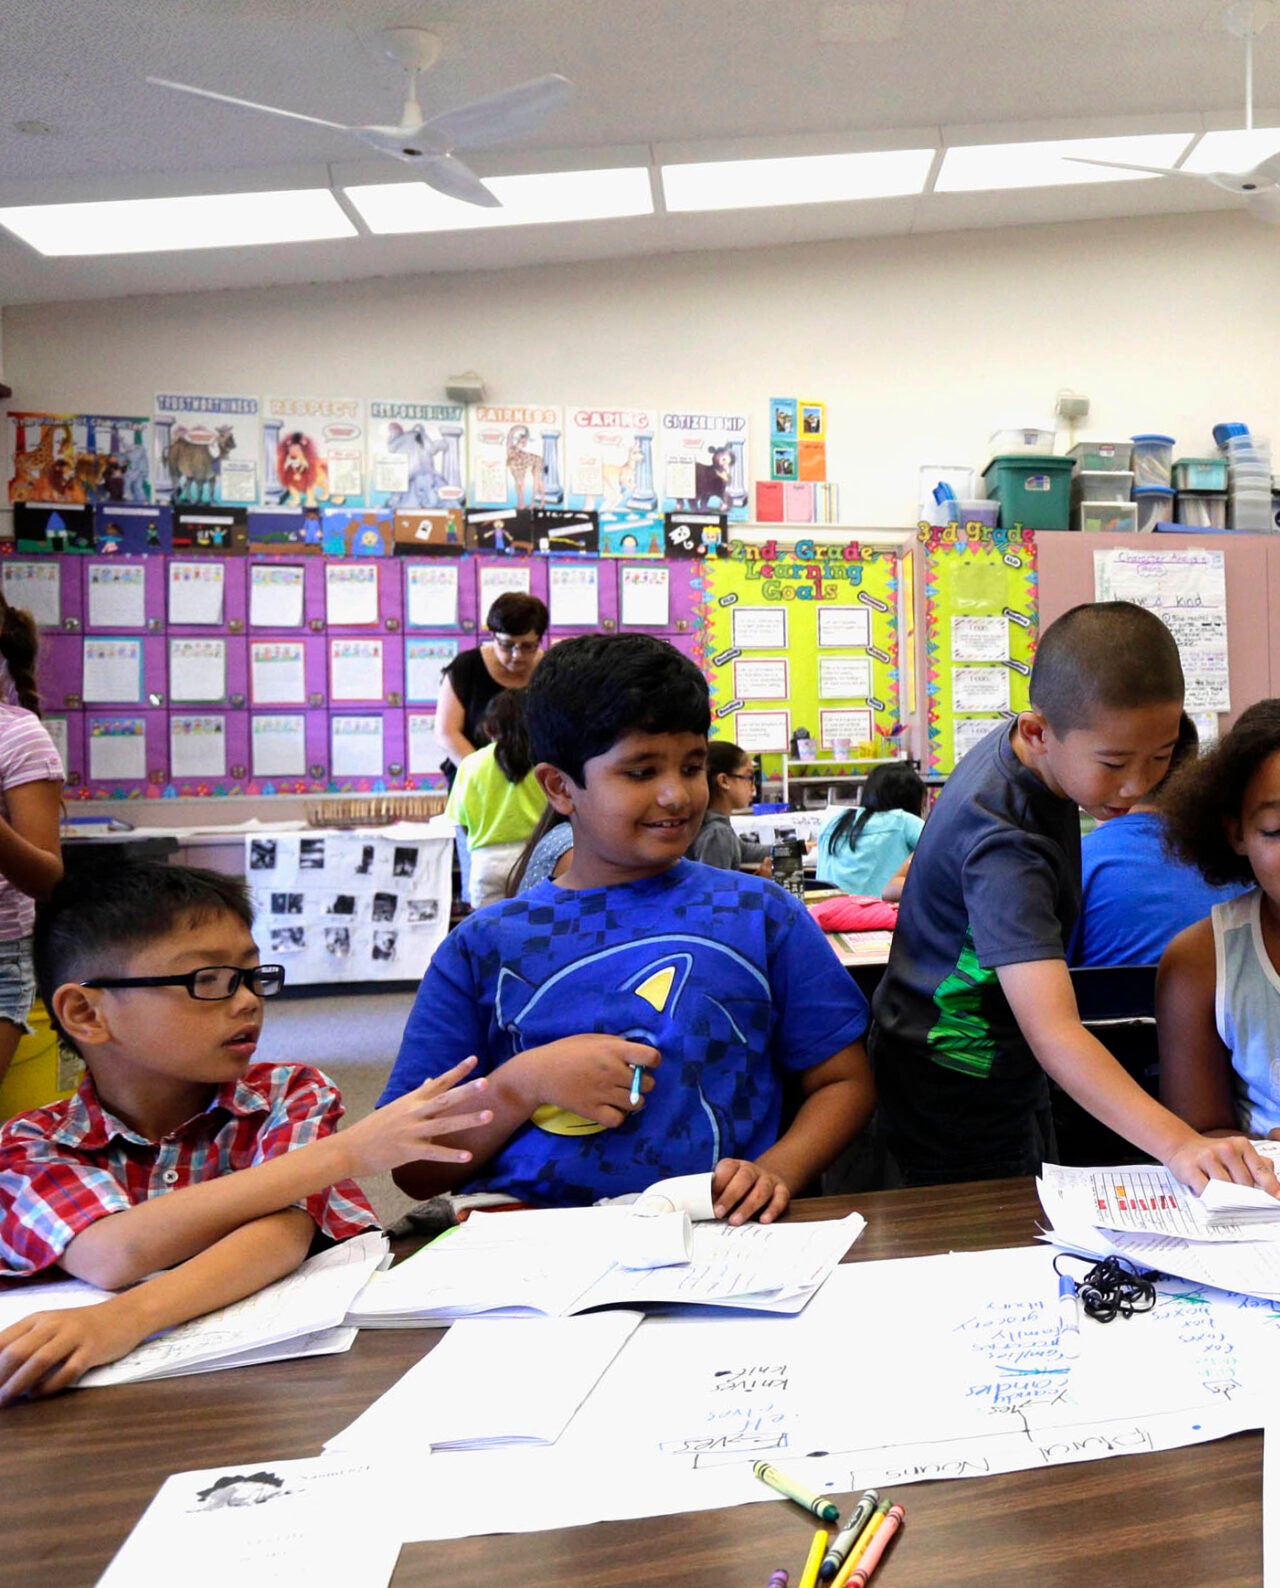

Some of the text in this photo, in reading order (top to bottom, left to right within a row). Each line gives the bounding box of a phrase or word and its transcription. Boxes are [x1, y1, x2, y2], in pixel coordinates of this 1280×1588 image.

[157, 395, 258, 414] TRUSTWORTHINESS
[269, 398, 359, 417] RESPECT
[371, 403, 464, 422] RESPONSIBILITY
[475, 407, 557, 424] FAIRNESS
[574, 411, 649, 429] CARING
[663, 412, 747, 432] CITIZENSHIP
[917, 521, 1036, 544] 3rd grade
[729, 540, 875, 561] 2nd Grade
[745, 560, 864, 585] Learning
[762, 581, 837, 601] Goals
[1175, 592, 1204, 606] kind
[1151, 1306, 1210, 1322] boxes
[711, 1378, 789, 1392] knives
[1038, 1426, 1155, 1463] Plural
[884, 1457, 990, 1482] Nouns
